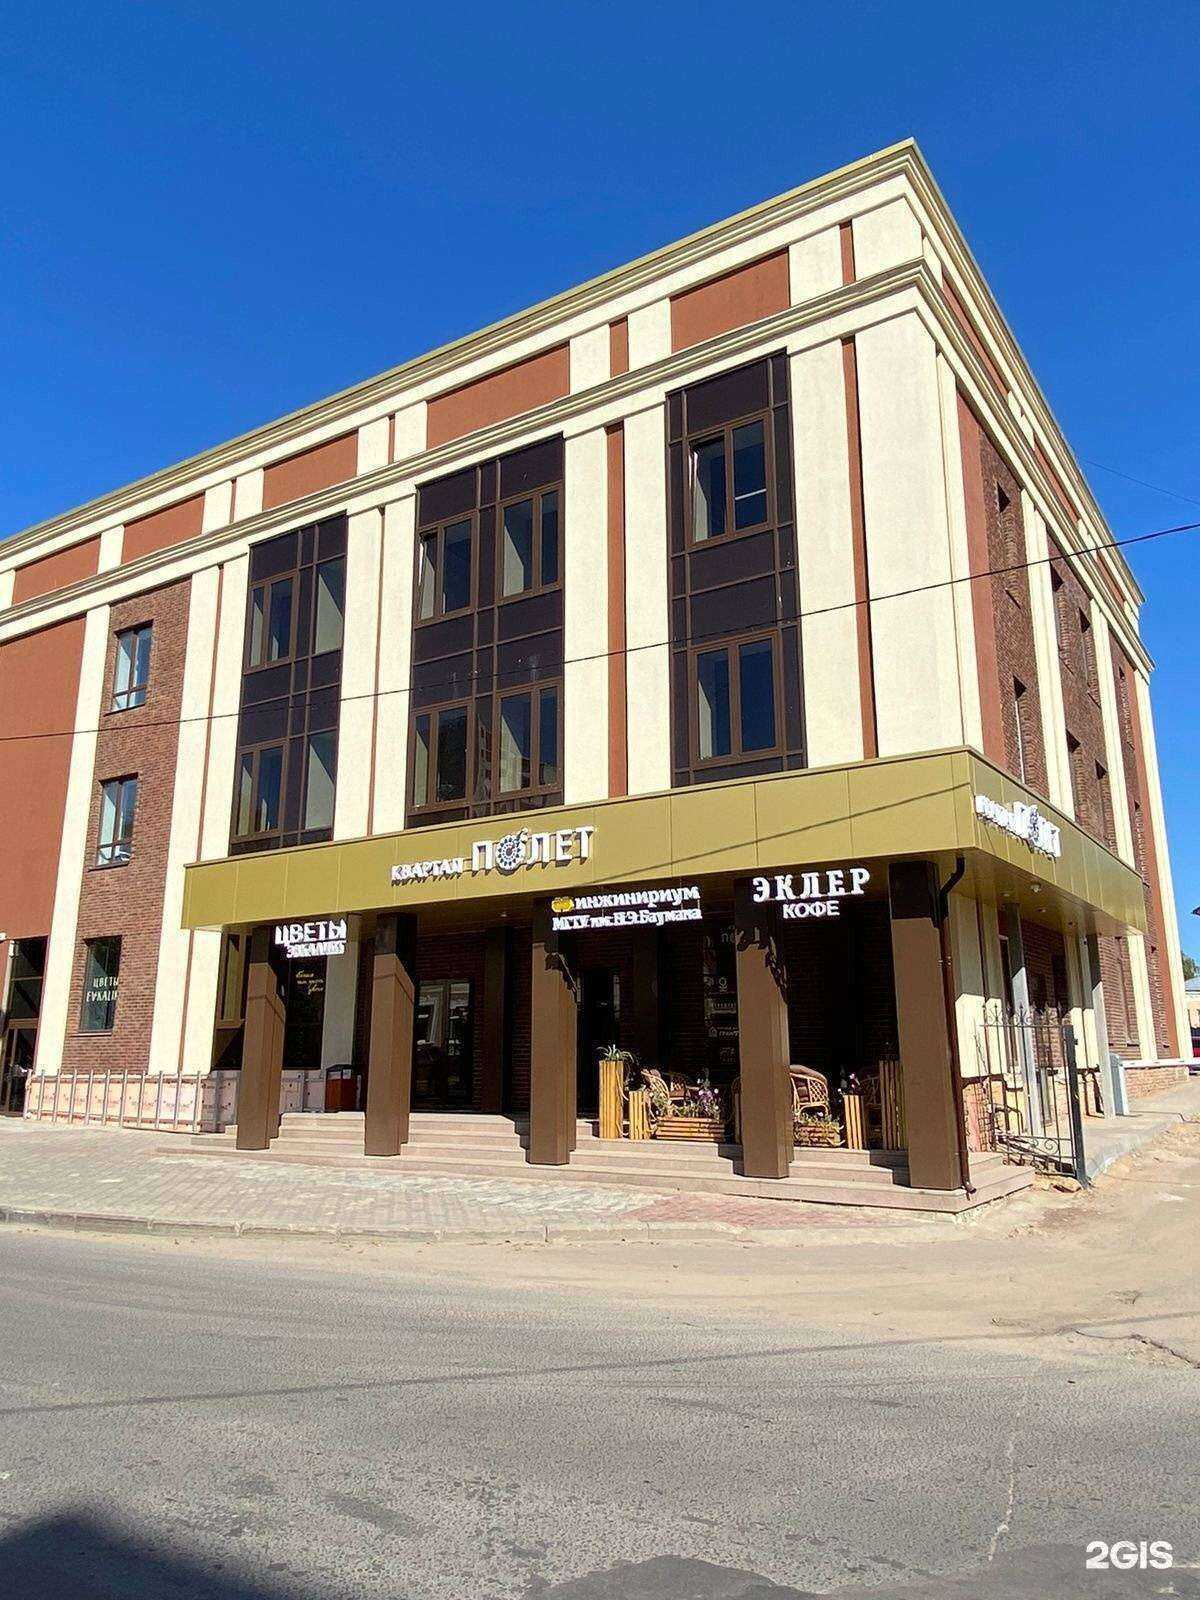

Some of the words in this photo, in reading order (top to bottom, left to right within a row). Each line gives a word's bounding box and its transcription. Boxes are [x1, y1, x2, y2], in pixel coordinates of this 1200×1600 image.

[574, 886, 701, 908] инжинириум
[752, 867, 871, 902] ЭКЛЕР
[783, 900, 840, 919] КОФЕ
[274, 918, 347, 946] ЦВЕТЫ
